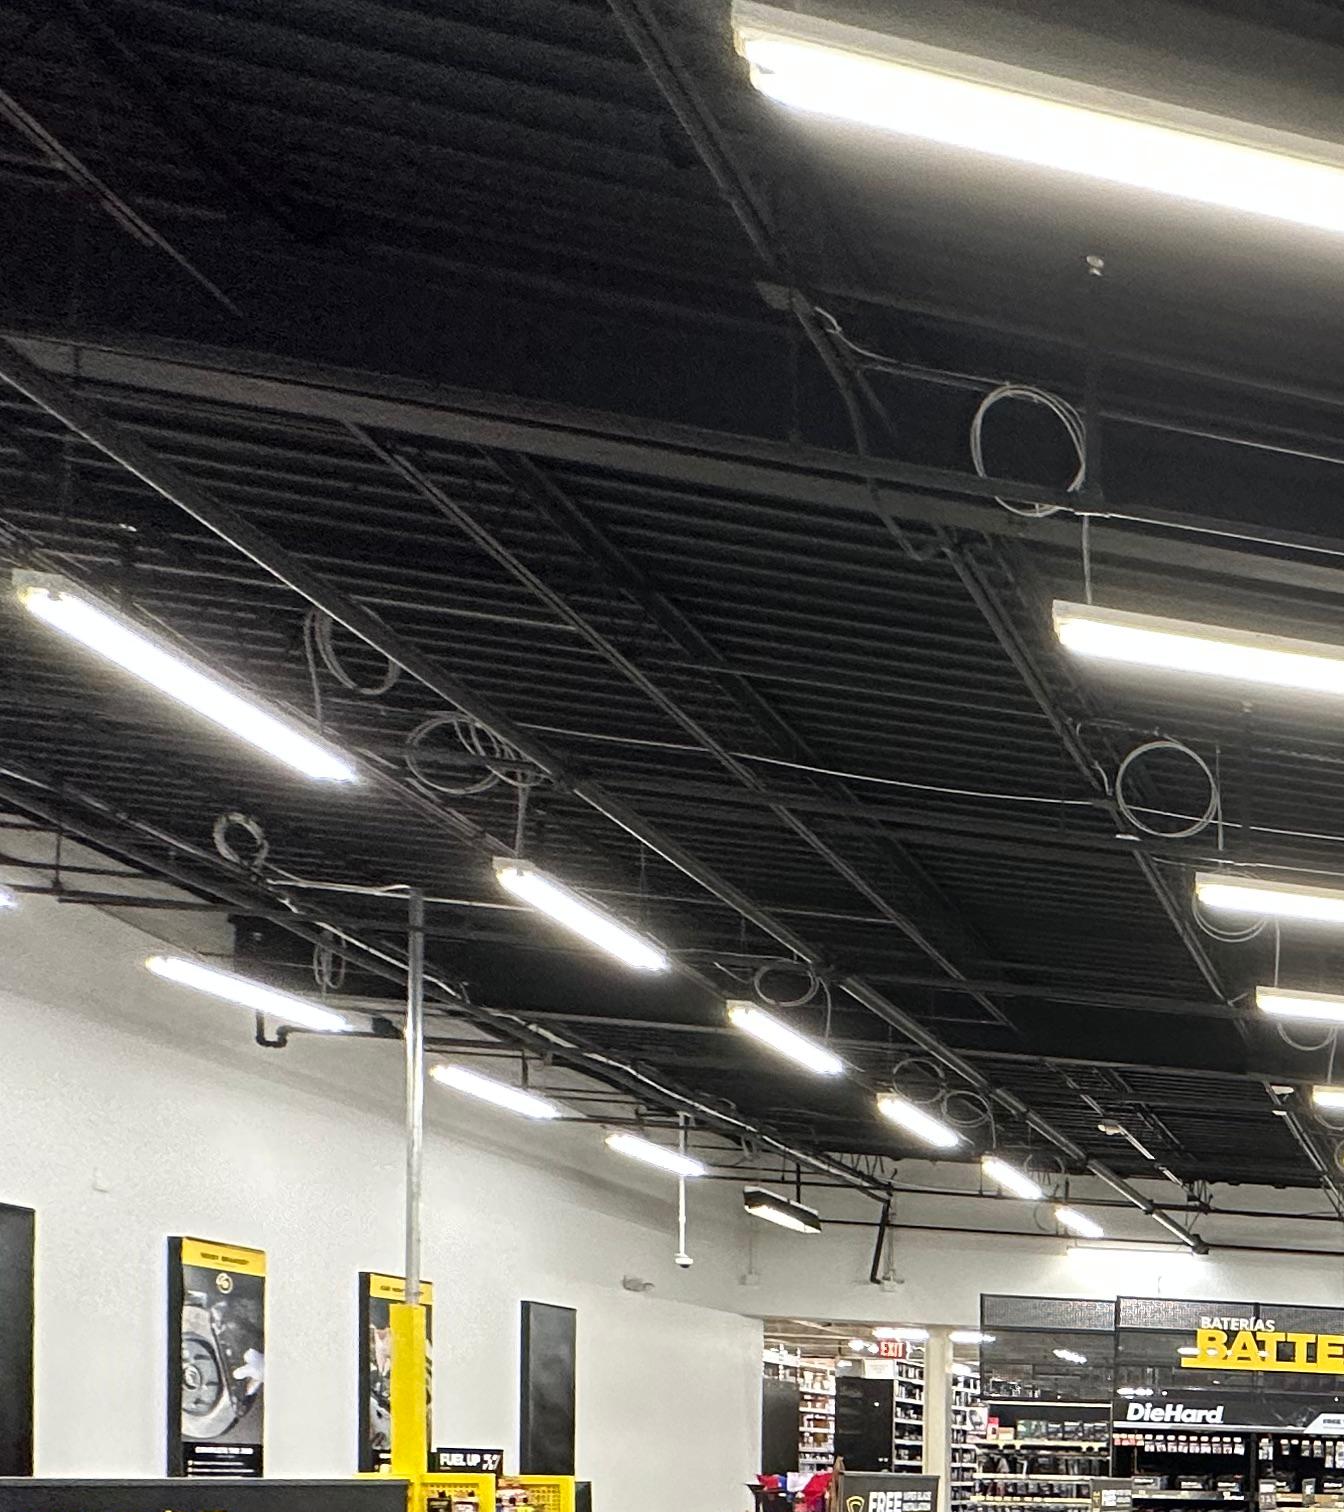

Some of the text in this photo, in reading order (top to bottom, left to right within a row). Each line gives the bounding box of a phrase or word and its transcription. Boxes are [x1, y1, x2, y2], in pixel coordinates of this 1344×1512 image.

[1201, 1316, 1275, 1332] BATERÍAS
[1127, 1402, 1223, 1424] DieHard
[440, 1454, 480, 1466] FUEL UP
